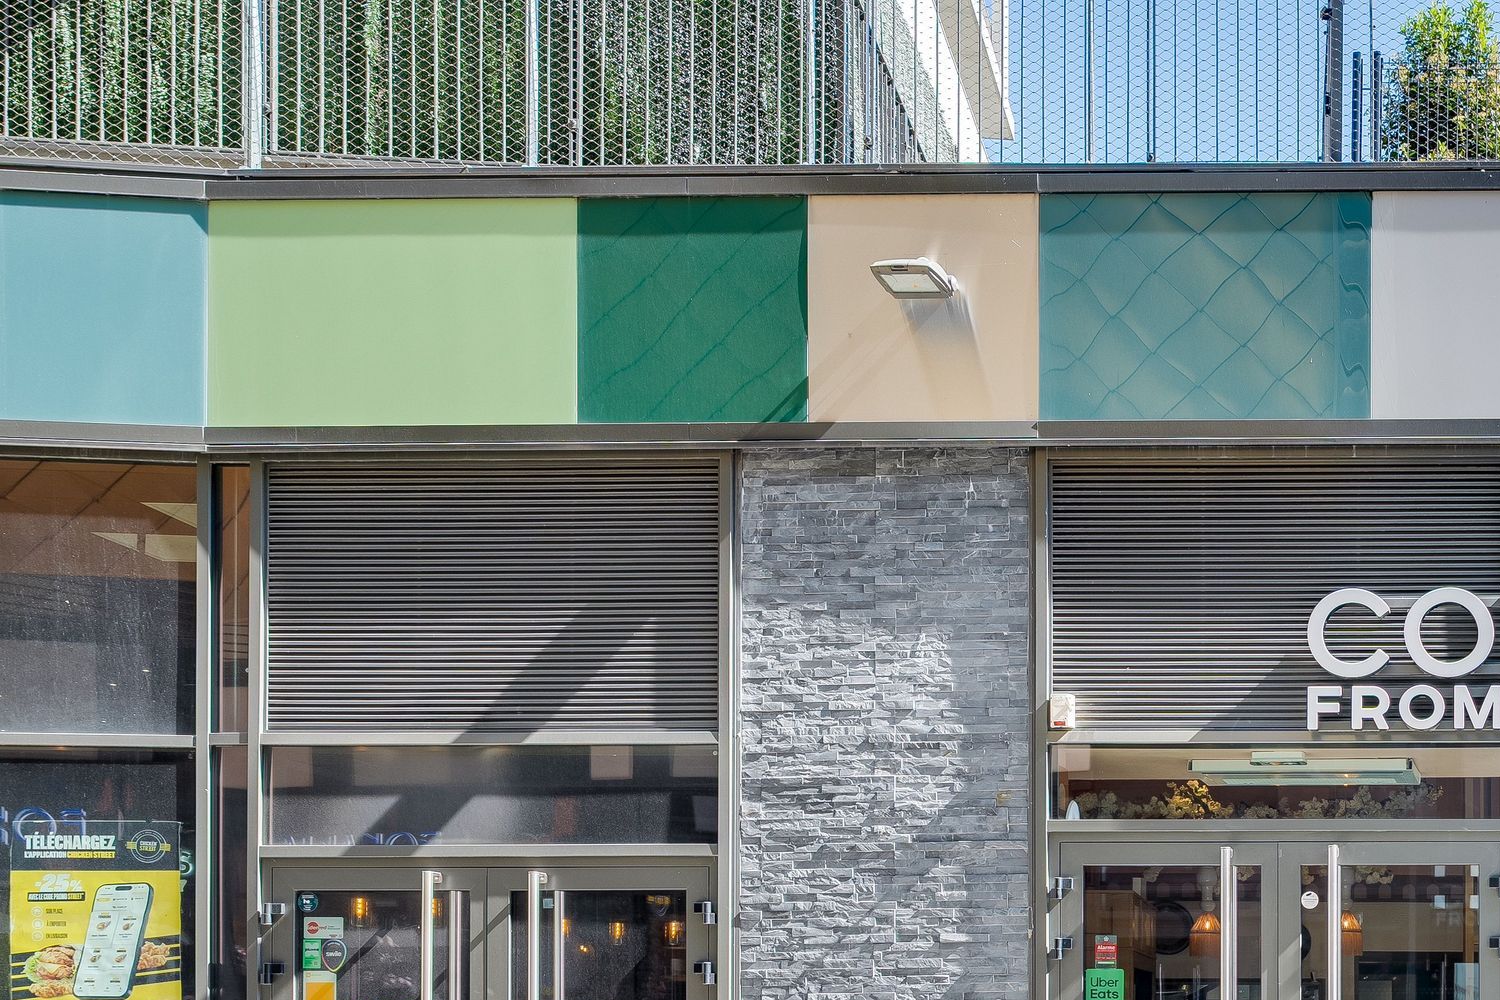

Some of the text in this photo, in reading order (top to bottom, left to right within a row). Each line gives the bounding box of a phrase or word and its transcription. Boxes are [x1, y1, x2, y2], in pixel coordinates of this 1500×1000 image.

[24, 831, 116, 850] TÉLÉCHARGEZ
[24, 851, 116, 859] L'APPLICATION CHICKEN STREET
[35, 873, 84, 893] -25%
[1090, 977, 1120, 988] Uber
[1090, 989, 1119, 999] Eats
